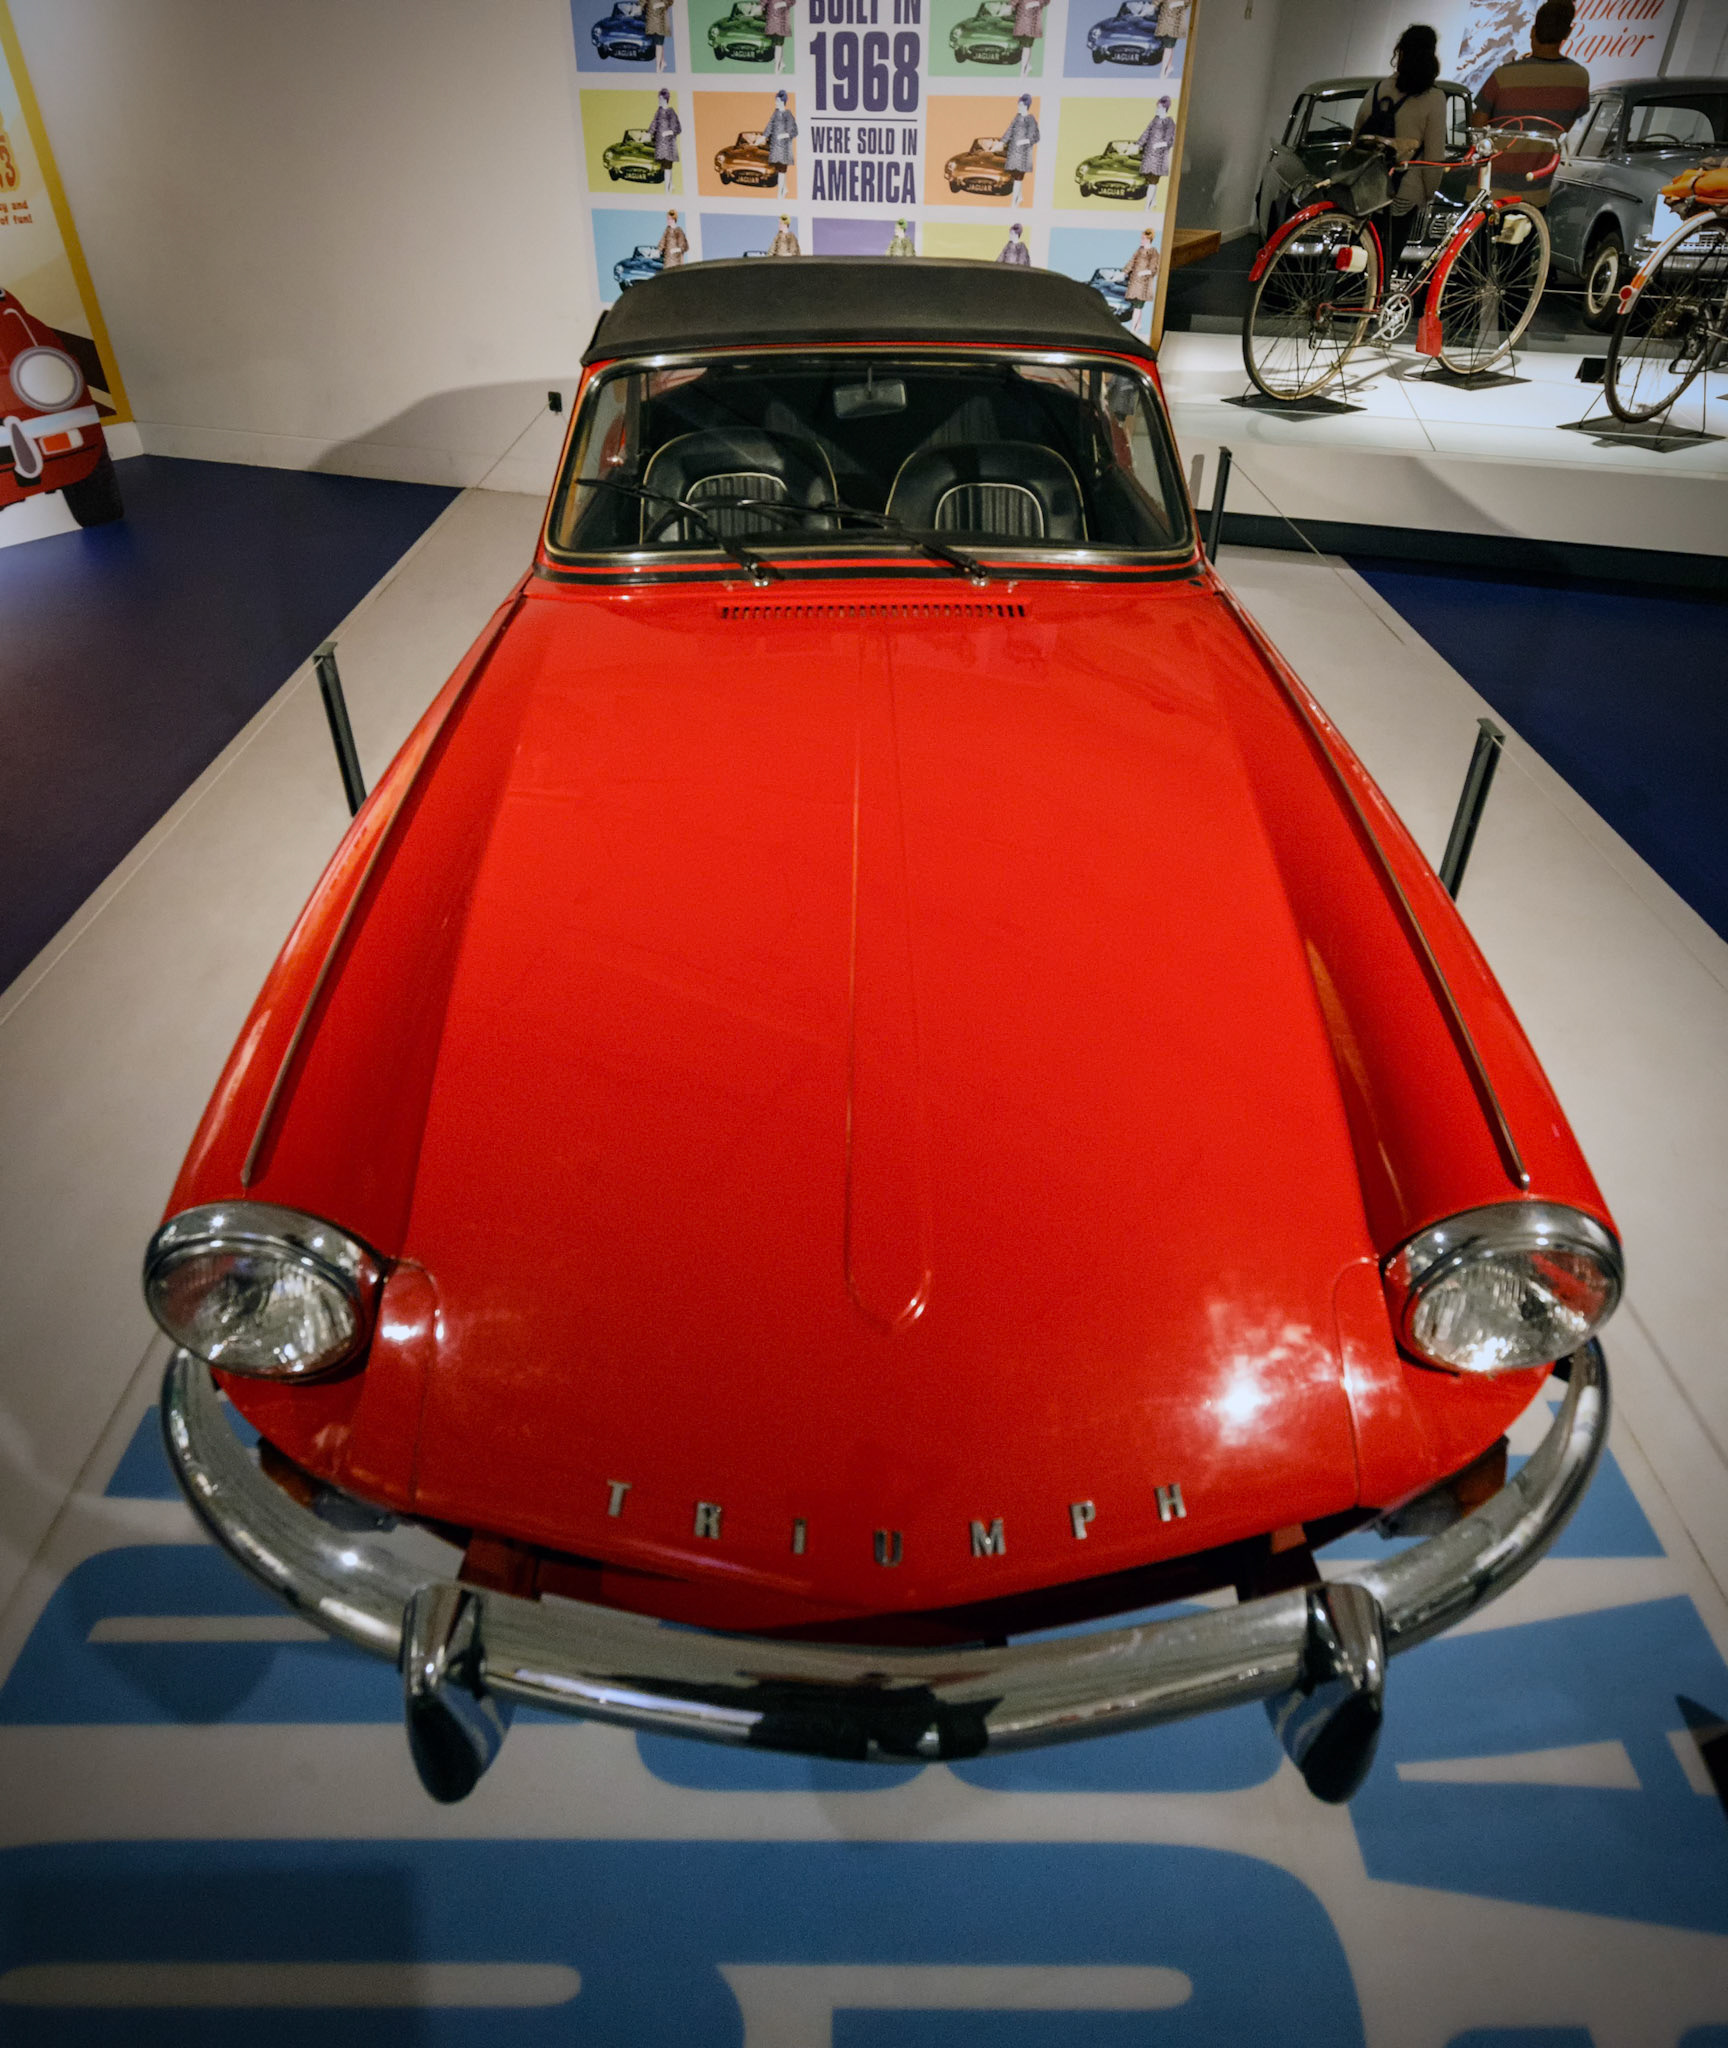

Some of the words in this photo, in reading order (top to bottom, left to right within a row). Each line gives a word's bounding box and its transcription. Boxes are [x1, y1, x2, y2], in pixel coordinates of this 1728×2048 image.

[1561, 22, 1655, 63] Rapier
[730, 50, 755, 58] JAGUAR
[972, 51, 1000, 61] JAGUAR
[1110, 52, 1140, 62] JAGUAR
[809, 31, 920, 112] 1968
[811, 126, 851, 153] WERE
[857, 127, 895, 155] SOLD
[902, 128, 917, 155] IN
[624, 172, 648, 181] JAGUAR
[735, 175, 760, 184] JAGUAR
[812, 159, 916, 204] AMERICA
[966, 182, 993, 192] JAGUAR
[1098, 186, 1126, 196] JAGUAR
[607, 1479, 1188, 1568] TRIUMPH
